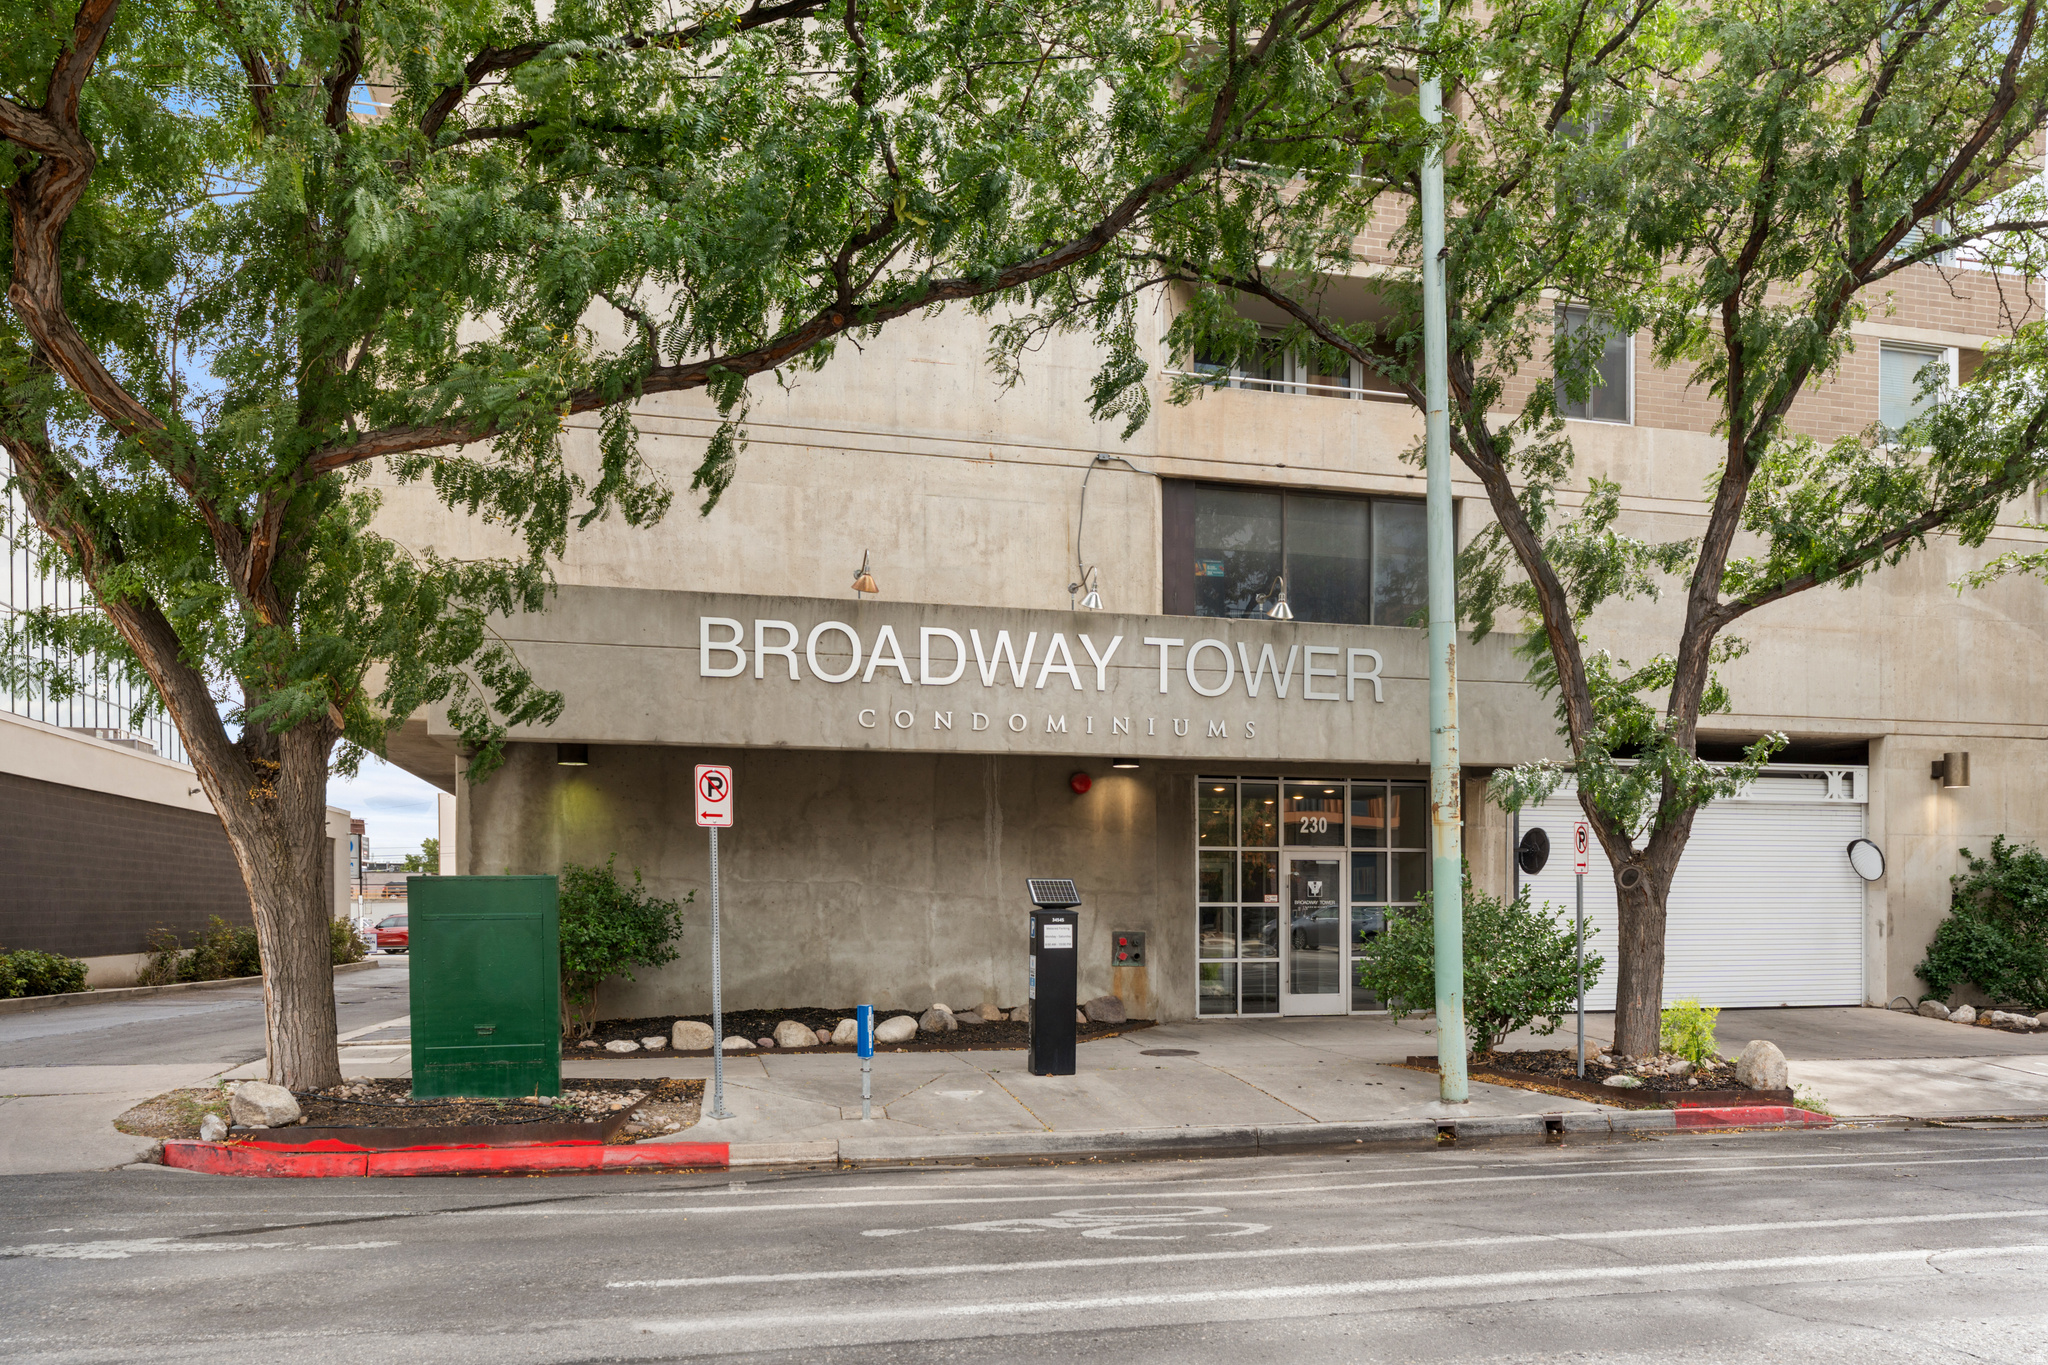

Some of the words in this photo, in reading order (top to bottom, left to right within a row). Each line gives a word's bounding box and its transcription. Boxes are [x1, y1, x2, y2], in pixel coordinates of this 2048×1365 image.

[699, 615, 1124, 692] BROADWAY
[1143, 635, 1385, 703] TOWER
[857, 708, 1257, 740] CONDOMINIUMS
[1300, 816, 1328, 834] 230
